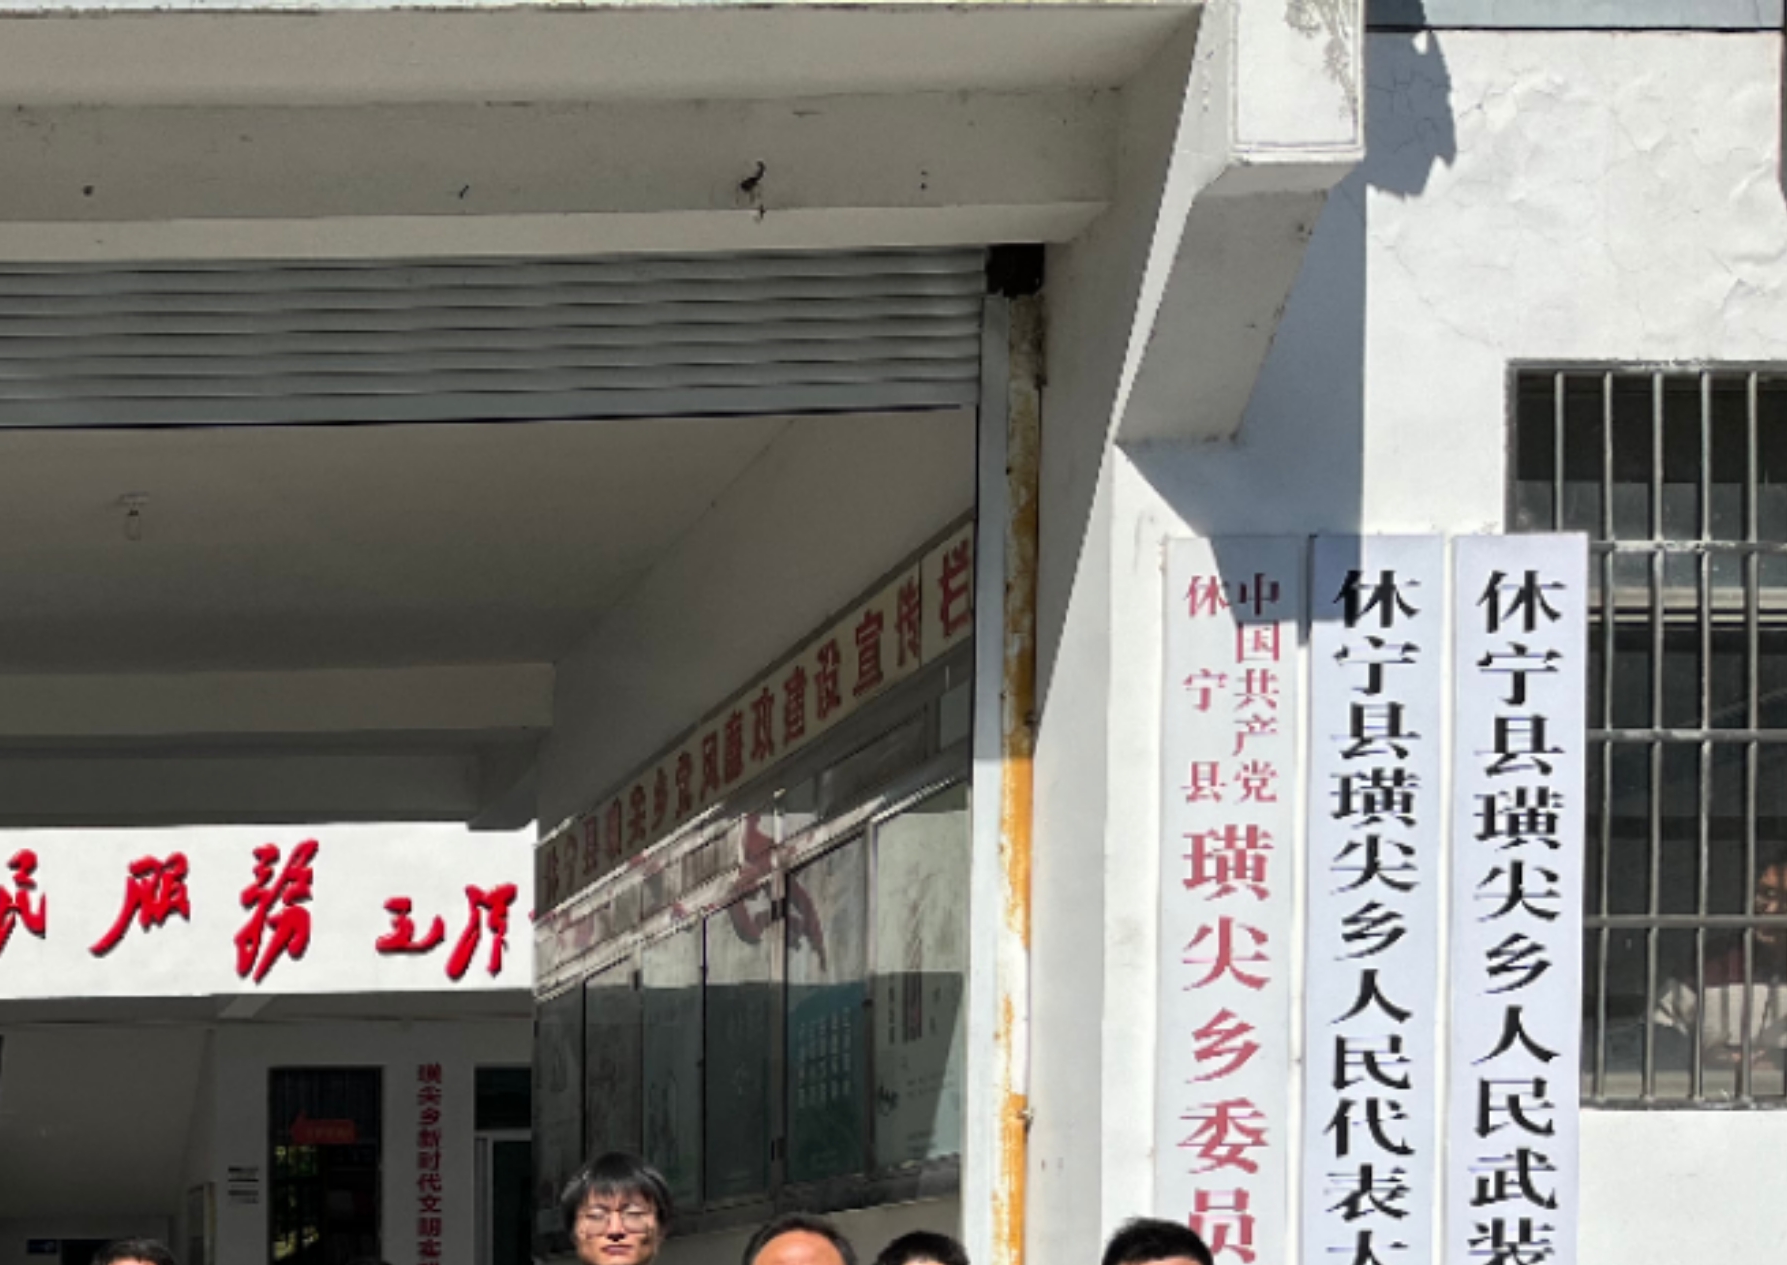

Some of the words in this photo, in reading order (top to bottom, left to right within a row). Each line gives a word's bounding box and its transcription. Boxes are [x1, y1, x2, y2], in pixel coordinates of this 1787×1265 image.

[1231, 573, 1280, 804] 中国共产党
